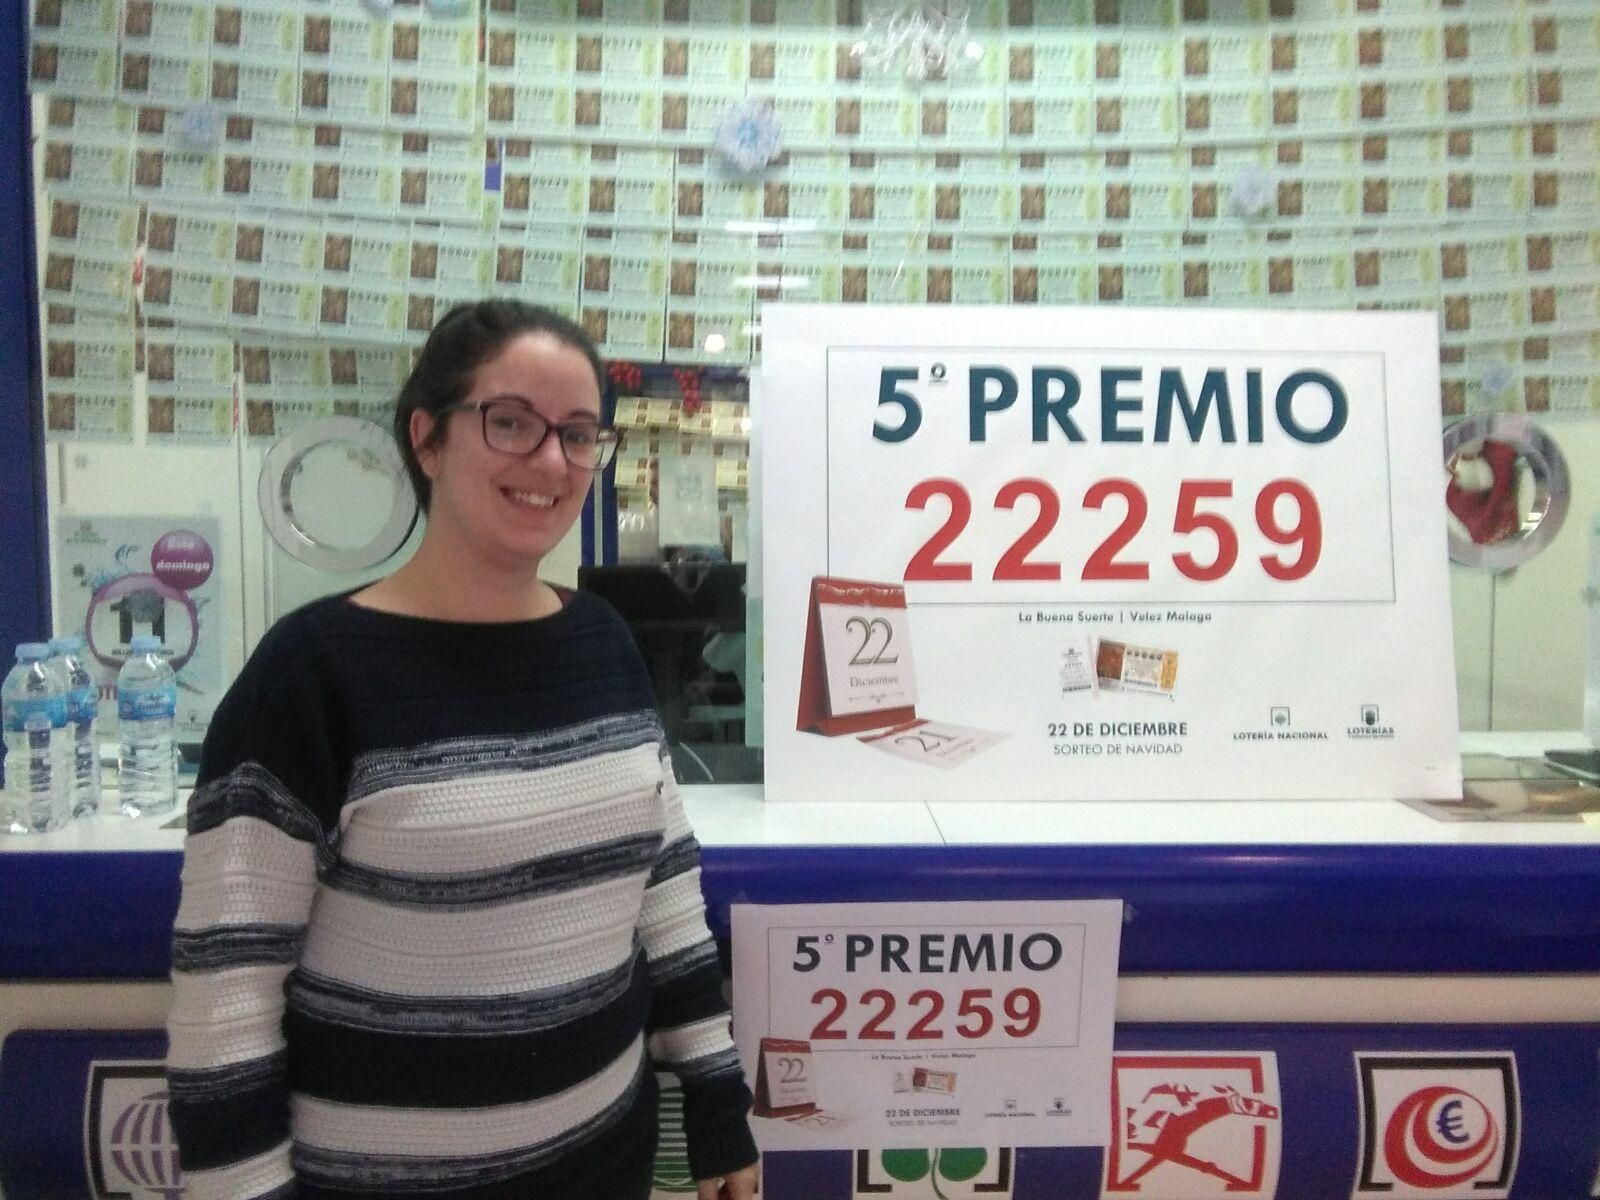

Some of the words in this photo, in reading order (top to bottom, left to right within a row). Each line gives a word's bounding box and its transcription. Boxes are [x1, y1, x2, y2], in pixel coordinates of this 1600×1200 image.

[968, 365, 1348, 445] PREMIO
[903, 477, 1322, 582] 22259
[156, 559, 210, 571] domingo
[1018, 613, 1032, 622] La
[1036, 612, 1073, 622] Buena
[1078, 611, 1113, 622] Suerte
[1129, 611, 1162, 622] Velez
[1167, 611, 1212, 624] Malaga
[846, 616, 899, 666] 22
[850, 674, 899, 688] Diciembre
[1047, 723, 1067, 737] 22
[1073, 723, 1094, 736] DE
[1100, 722, 1187, 736] DICIEMBRE
[1277, 731, 1328, 740] NACIONAL
[1053, 743, 1102, 755] SORTEO
[1106, 744, 1122, 755] DE
[1126, 743, 1183, 755] NAVIDAD
[846, 932, 1062, 972] PREMIO
[810, 988, 1041, 1040] 22259
[778, 1057, 807, 1083] 22
